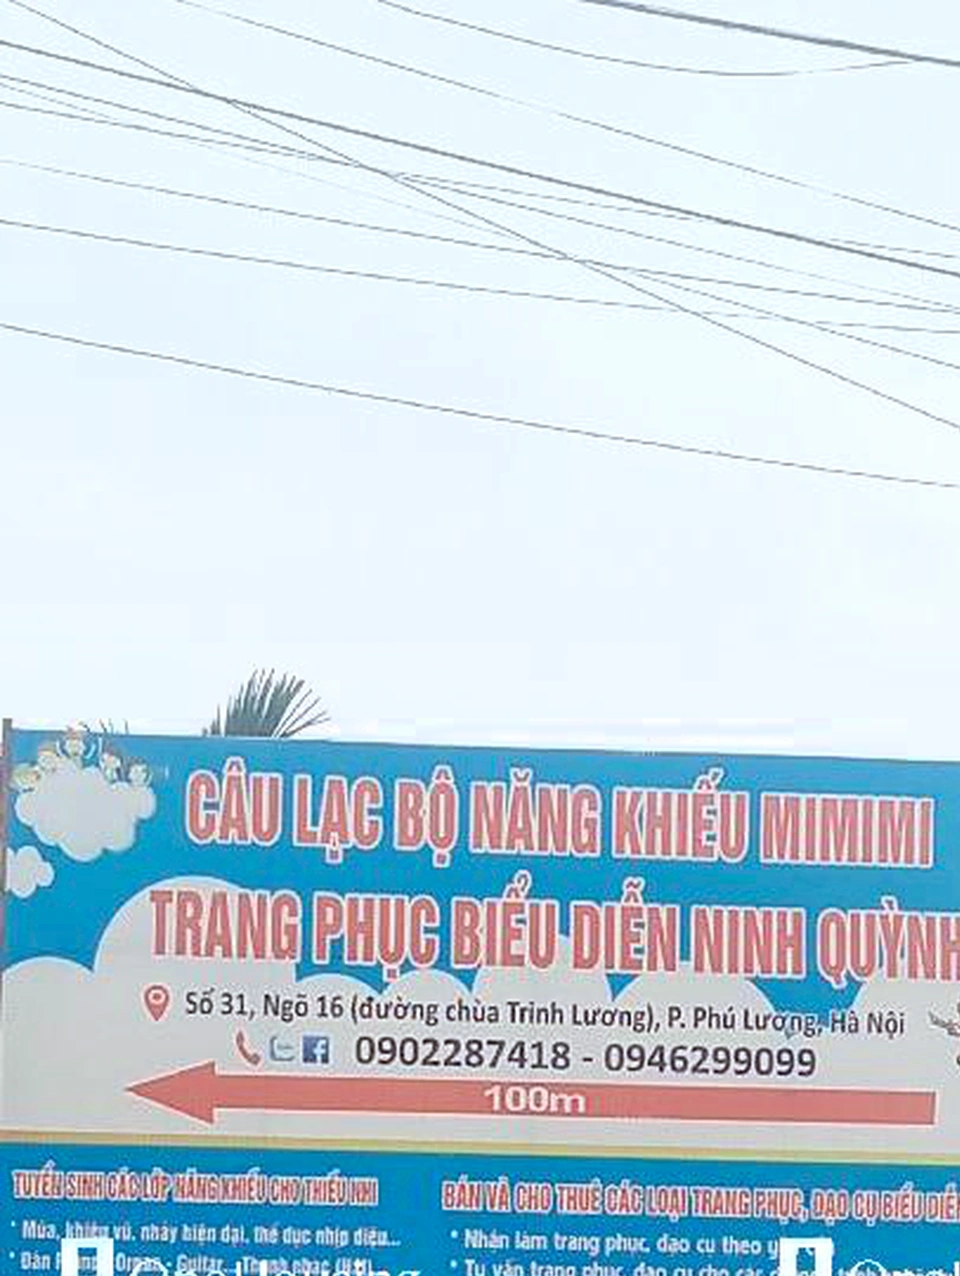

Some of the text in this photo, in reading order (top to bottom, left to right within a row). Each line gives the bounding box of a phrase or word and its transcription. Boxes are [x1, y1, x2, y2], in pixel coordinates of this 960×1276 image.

[186, 757, 935, 868] CÂU LẠC BỘ NĂNG KHIẾU MIMIMI
[149, 890, 302, 962] TRANG
[313, 892, 441, 983] PHỤC
[451, 870, 558, 969] BIỂU
[570, 876, 678, 974] DIỄN
[690, 906, 806, 978] NINH
[186, 989, 214, 1016] Số
[220, 994, 255, 1019] 31,
[263, 994, 308, 1022] Ngõ
[317, 996, 343, 1018] 16
[350, 993, 439, 1026] (đường
[446, 999, 499, 1023] chùa
[572, 1003, 661, 1034] Lương),
[668, 1006, 687, 1030] P.
[693, 1007, 736, 1031] Phú
[830, 1013, 860, 1034] Hà
[867, 1012, 905, 1039] Nội
[355, 1036, 570, 1070] 0902287418
[604, 1043, 816, 1077] 0946299099
[484, 1085, 587, 1114] 100m
[12, 1160, 380, 1207] TUYỂN SINH CÁC LỚP NĂNG KHIẾU CHO THIẾU NHI
[442, 1174, 483, 1210] BÁN
[484, 1176, 511, 1212] VÀ
[515, 1182, 552, 1213] CHO
[556, 1177, 602, 1215] THUÊ
[604, 1180, 644, 1216] CÁC
[645, 1186, 688, 1221] LOẠI
[690, 1186, 750, 1217] TRANG
[753, 1187, 809, 1224] PHỤC,
[852, 1191, 881, 1226] CỤ
[515, 1228, 548, 1249] làm
[553, 1232, 600, 1257] trang
[722, 1236, 762, 1256] theo
